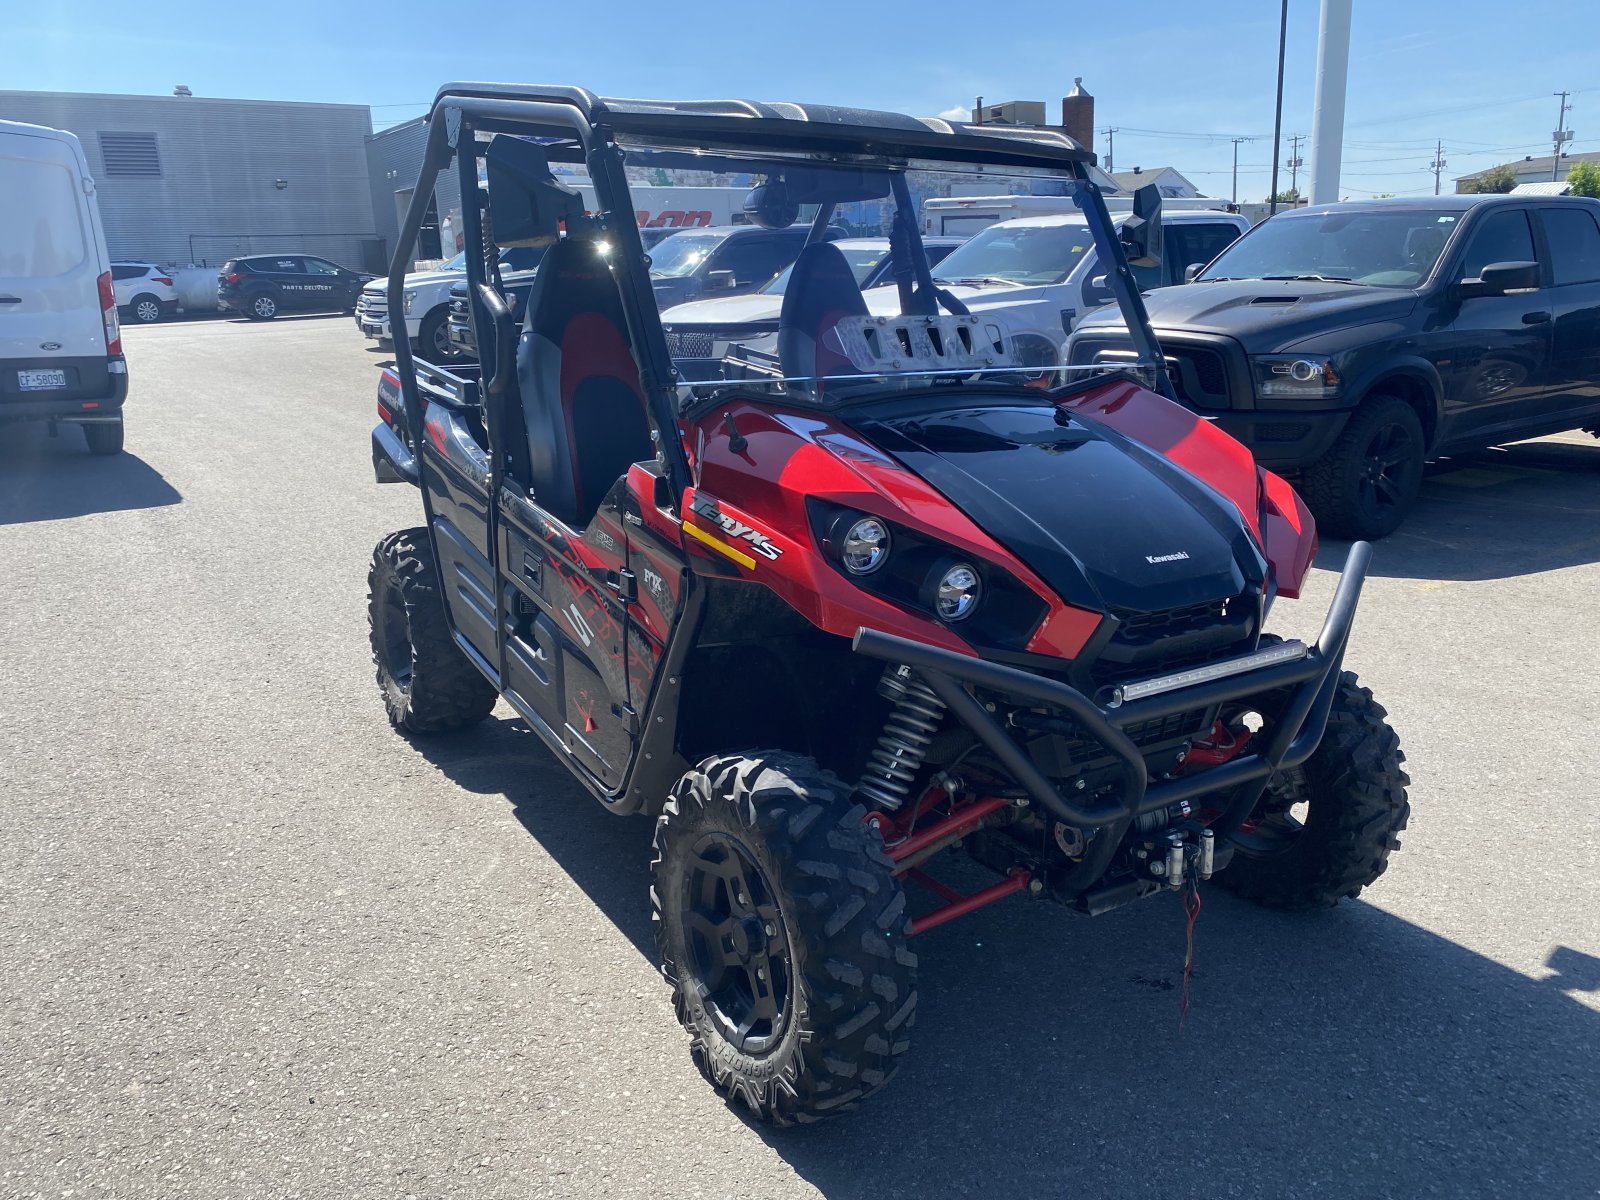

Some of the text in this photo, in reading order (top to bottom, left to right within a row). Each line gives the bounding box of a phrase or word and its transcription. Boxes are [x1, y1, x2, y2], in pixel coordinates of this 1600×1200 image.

[20, 373, 65, 386] CF 58090
[1145, 551, 1190, 564] Kawasaki
[643, 568, 662, 592] FOX
